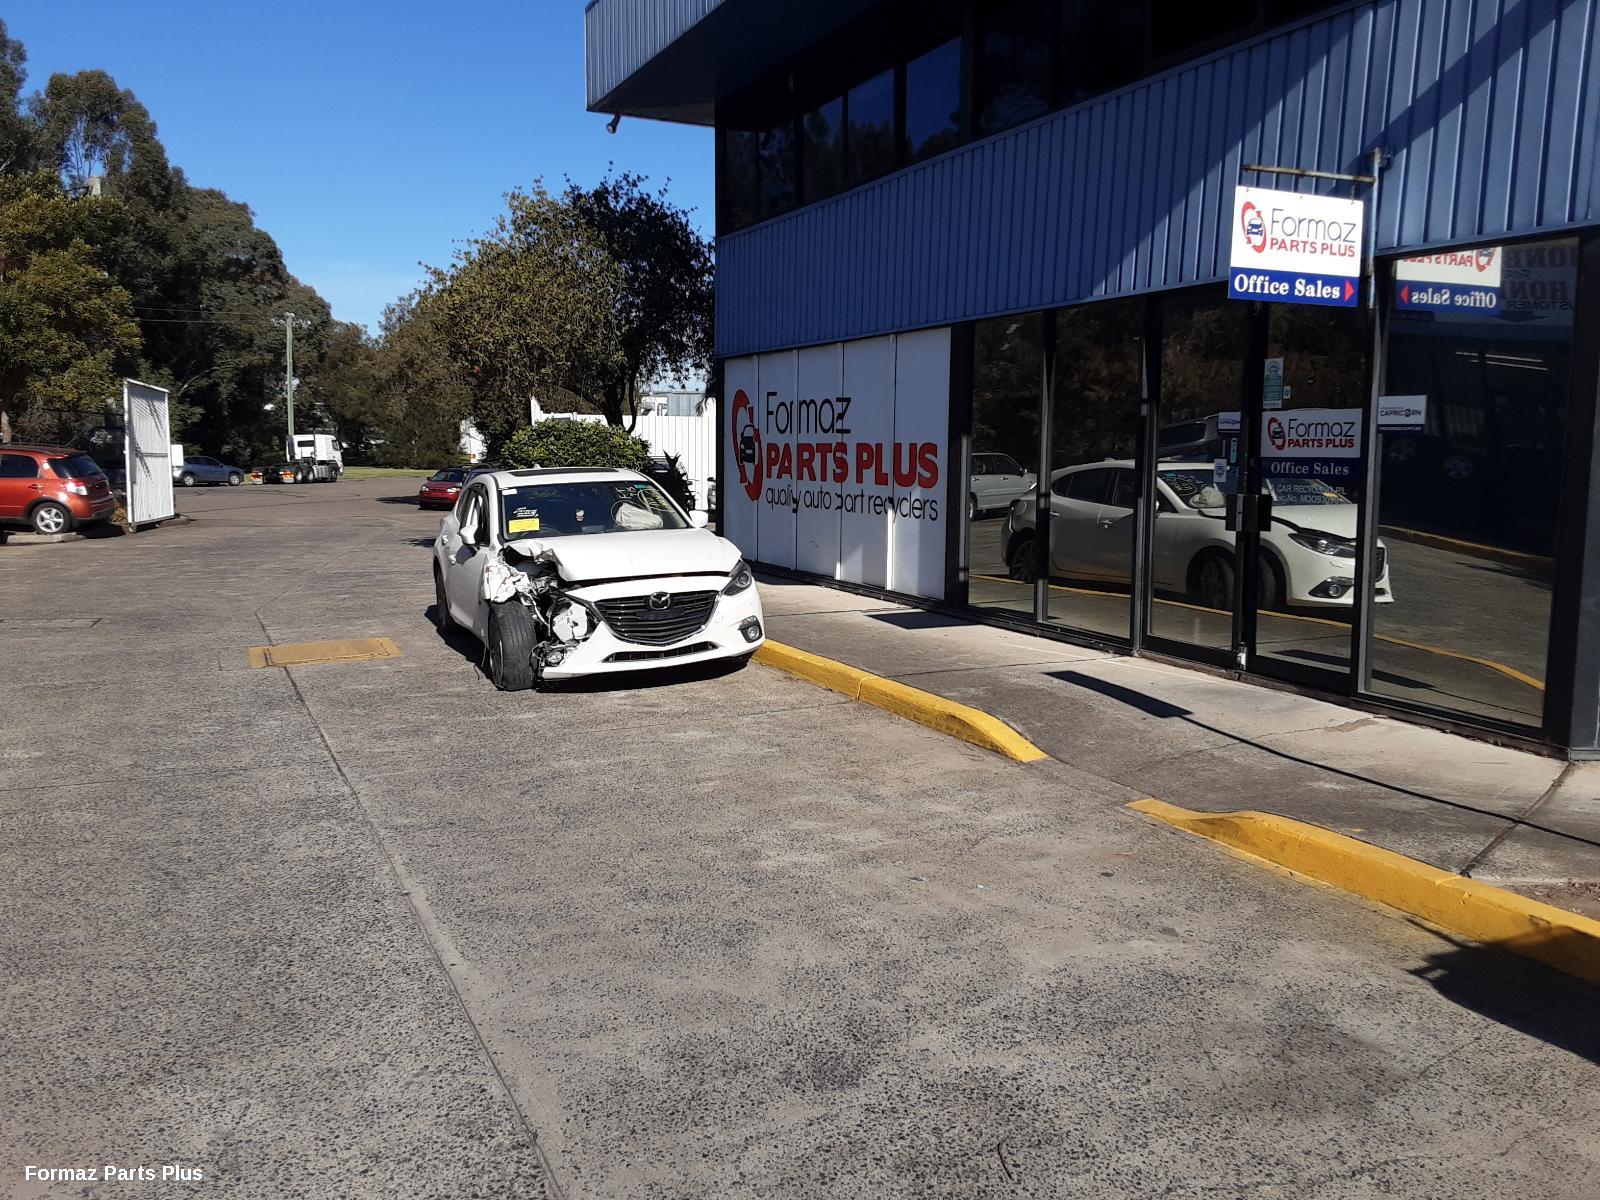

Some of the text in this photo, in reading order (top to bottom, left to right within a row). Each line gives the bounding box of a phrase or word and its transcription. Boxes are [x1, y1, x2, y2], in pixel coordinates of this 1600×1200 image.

[1270, 207, 1357, 243] Formaz
[1269, 237, 1355, 258] PARTS PLUS
[1233, 273, 1340, 300] Office Sales
[766, 391, 852, 434] Formaz
[1287, 418, 1355, 437] Formaz
[1287, 438, 1354, 448] PARTS PLUS
[766, 441, 939, 489] PARTS PLUS
[1270, 461, 1350, 476] Office Sales
[803, 485, 832, 509] auto
[868, 490, 938, 523] recyclers
